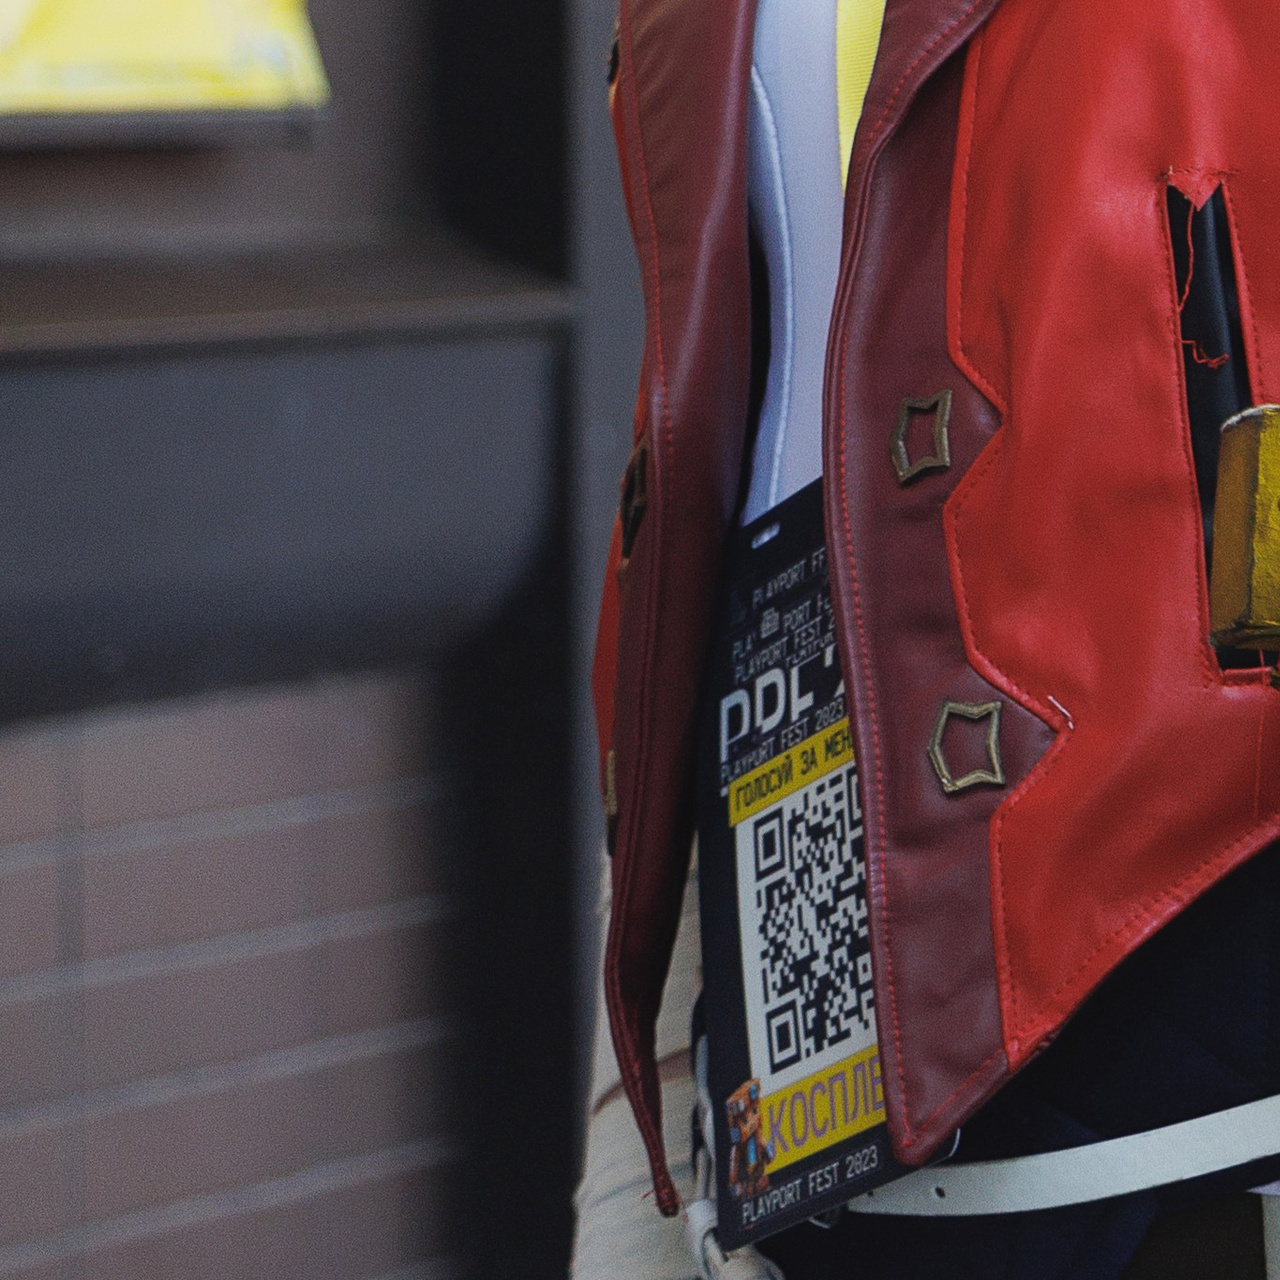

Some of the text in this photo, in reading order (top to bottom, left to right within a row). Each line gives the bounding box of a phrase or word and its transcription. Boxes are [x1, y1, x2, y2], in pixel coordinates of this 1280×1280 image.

[720, 737, 775, 787] PLAYPORT
[781, 717, 809, 751] FEST
[735, 727, 856, 813] ГОЛОСУЙ ЗА МЕН
[742, 1144, 878, 1224] PLAYPORT FEST 2023
